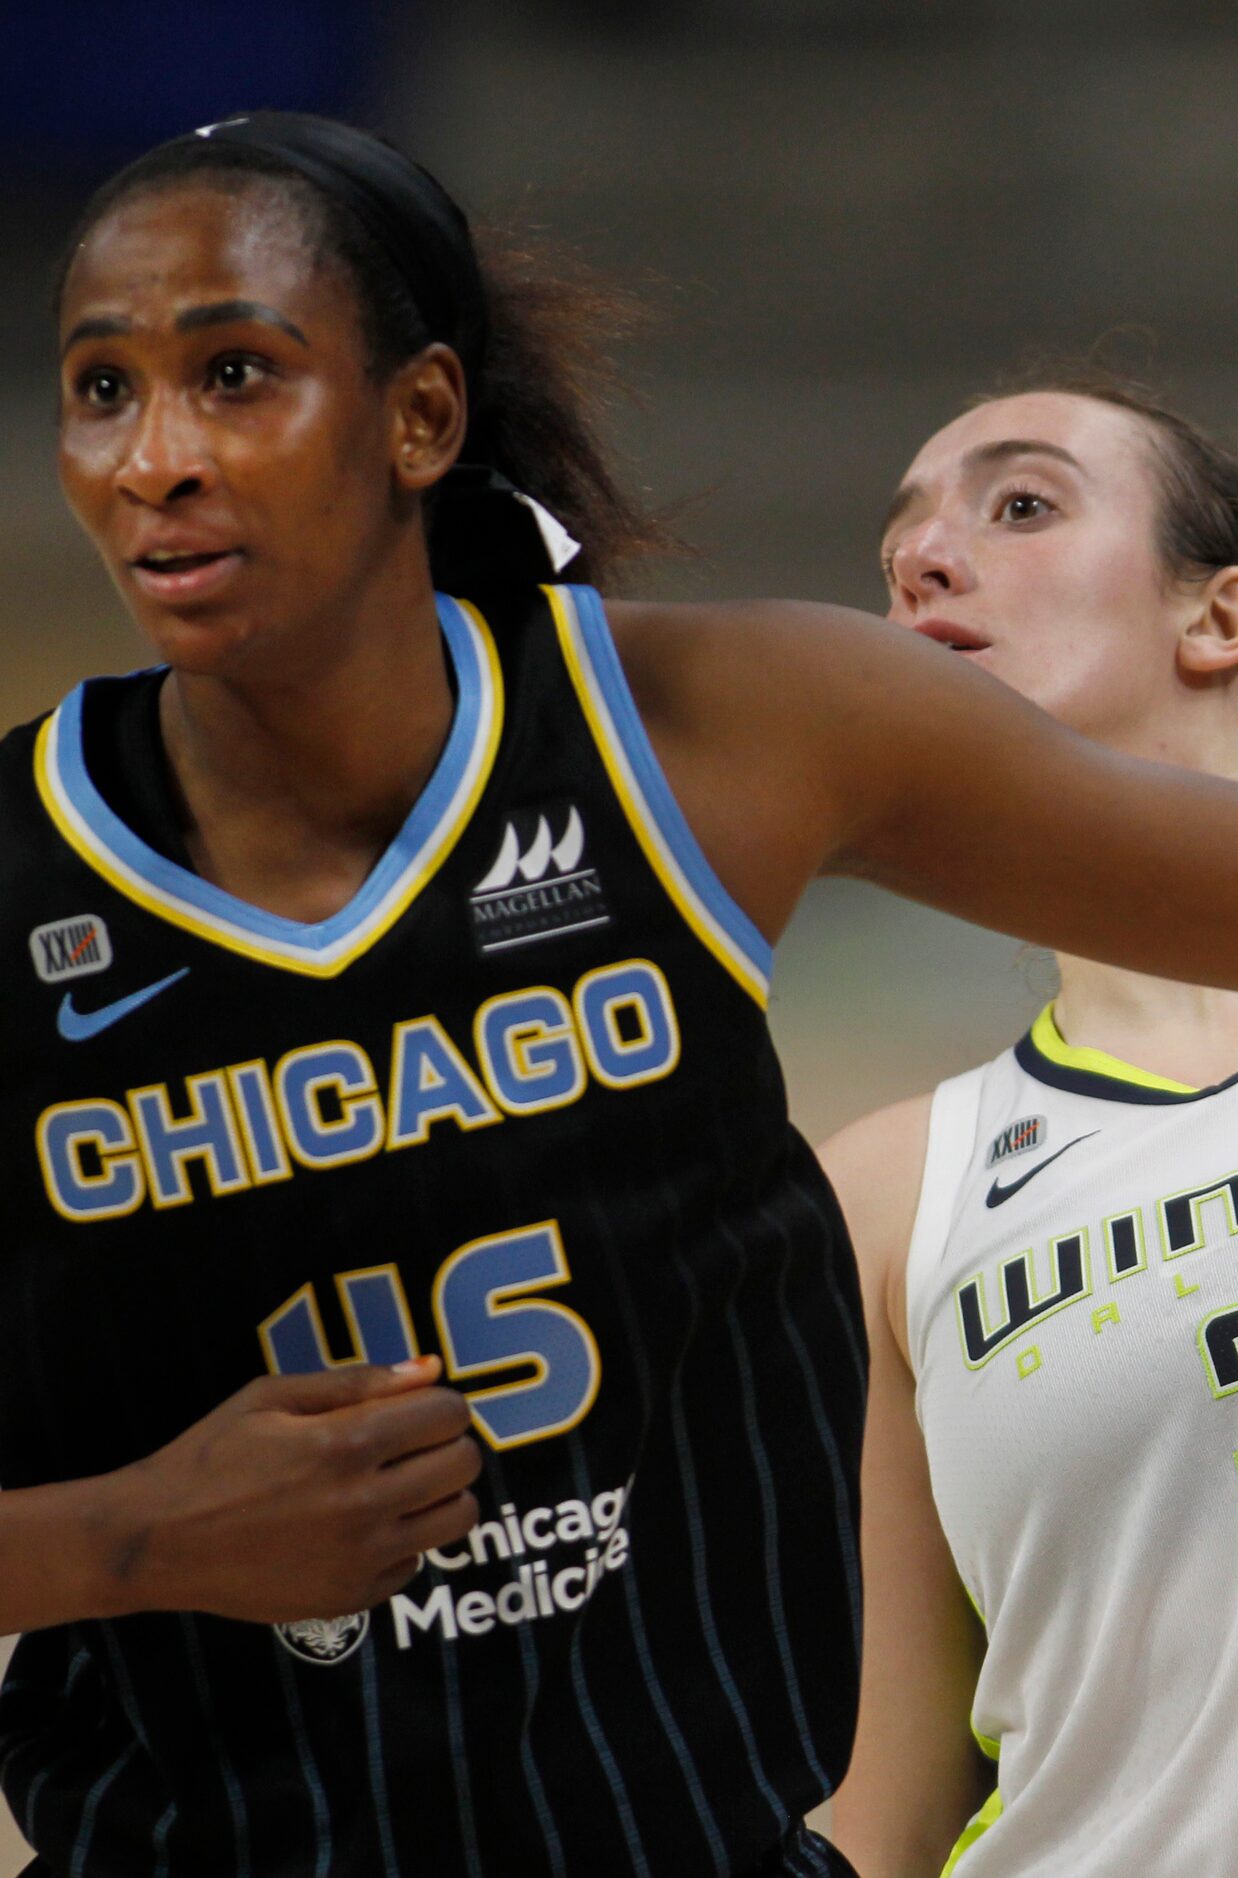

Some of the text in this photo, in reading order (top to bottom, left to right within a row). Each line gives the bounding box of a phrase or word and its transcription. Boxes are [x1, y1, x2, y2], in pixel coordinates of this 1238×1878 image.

[473, 874, 602, 922] MAGELLAN
[35, 957, 681, 1222] CHICAGO
[390, 1526, 629, 1650] Medicie
